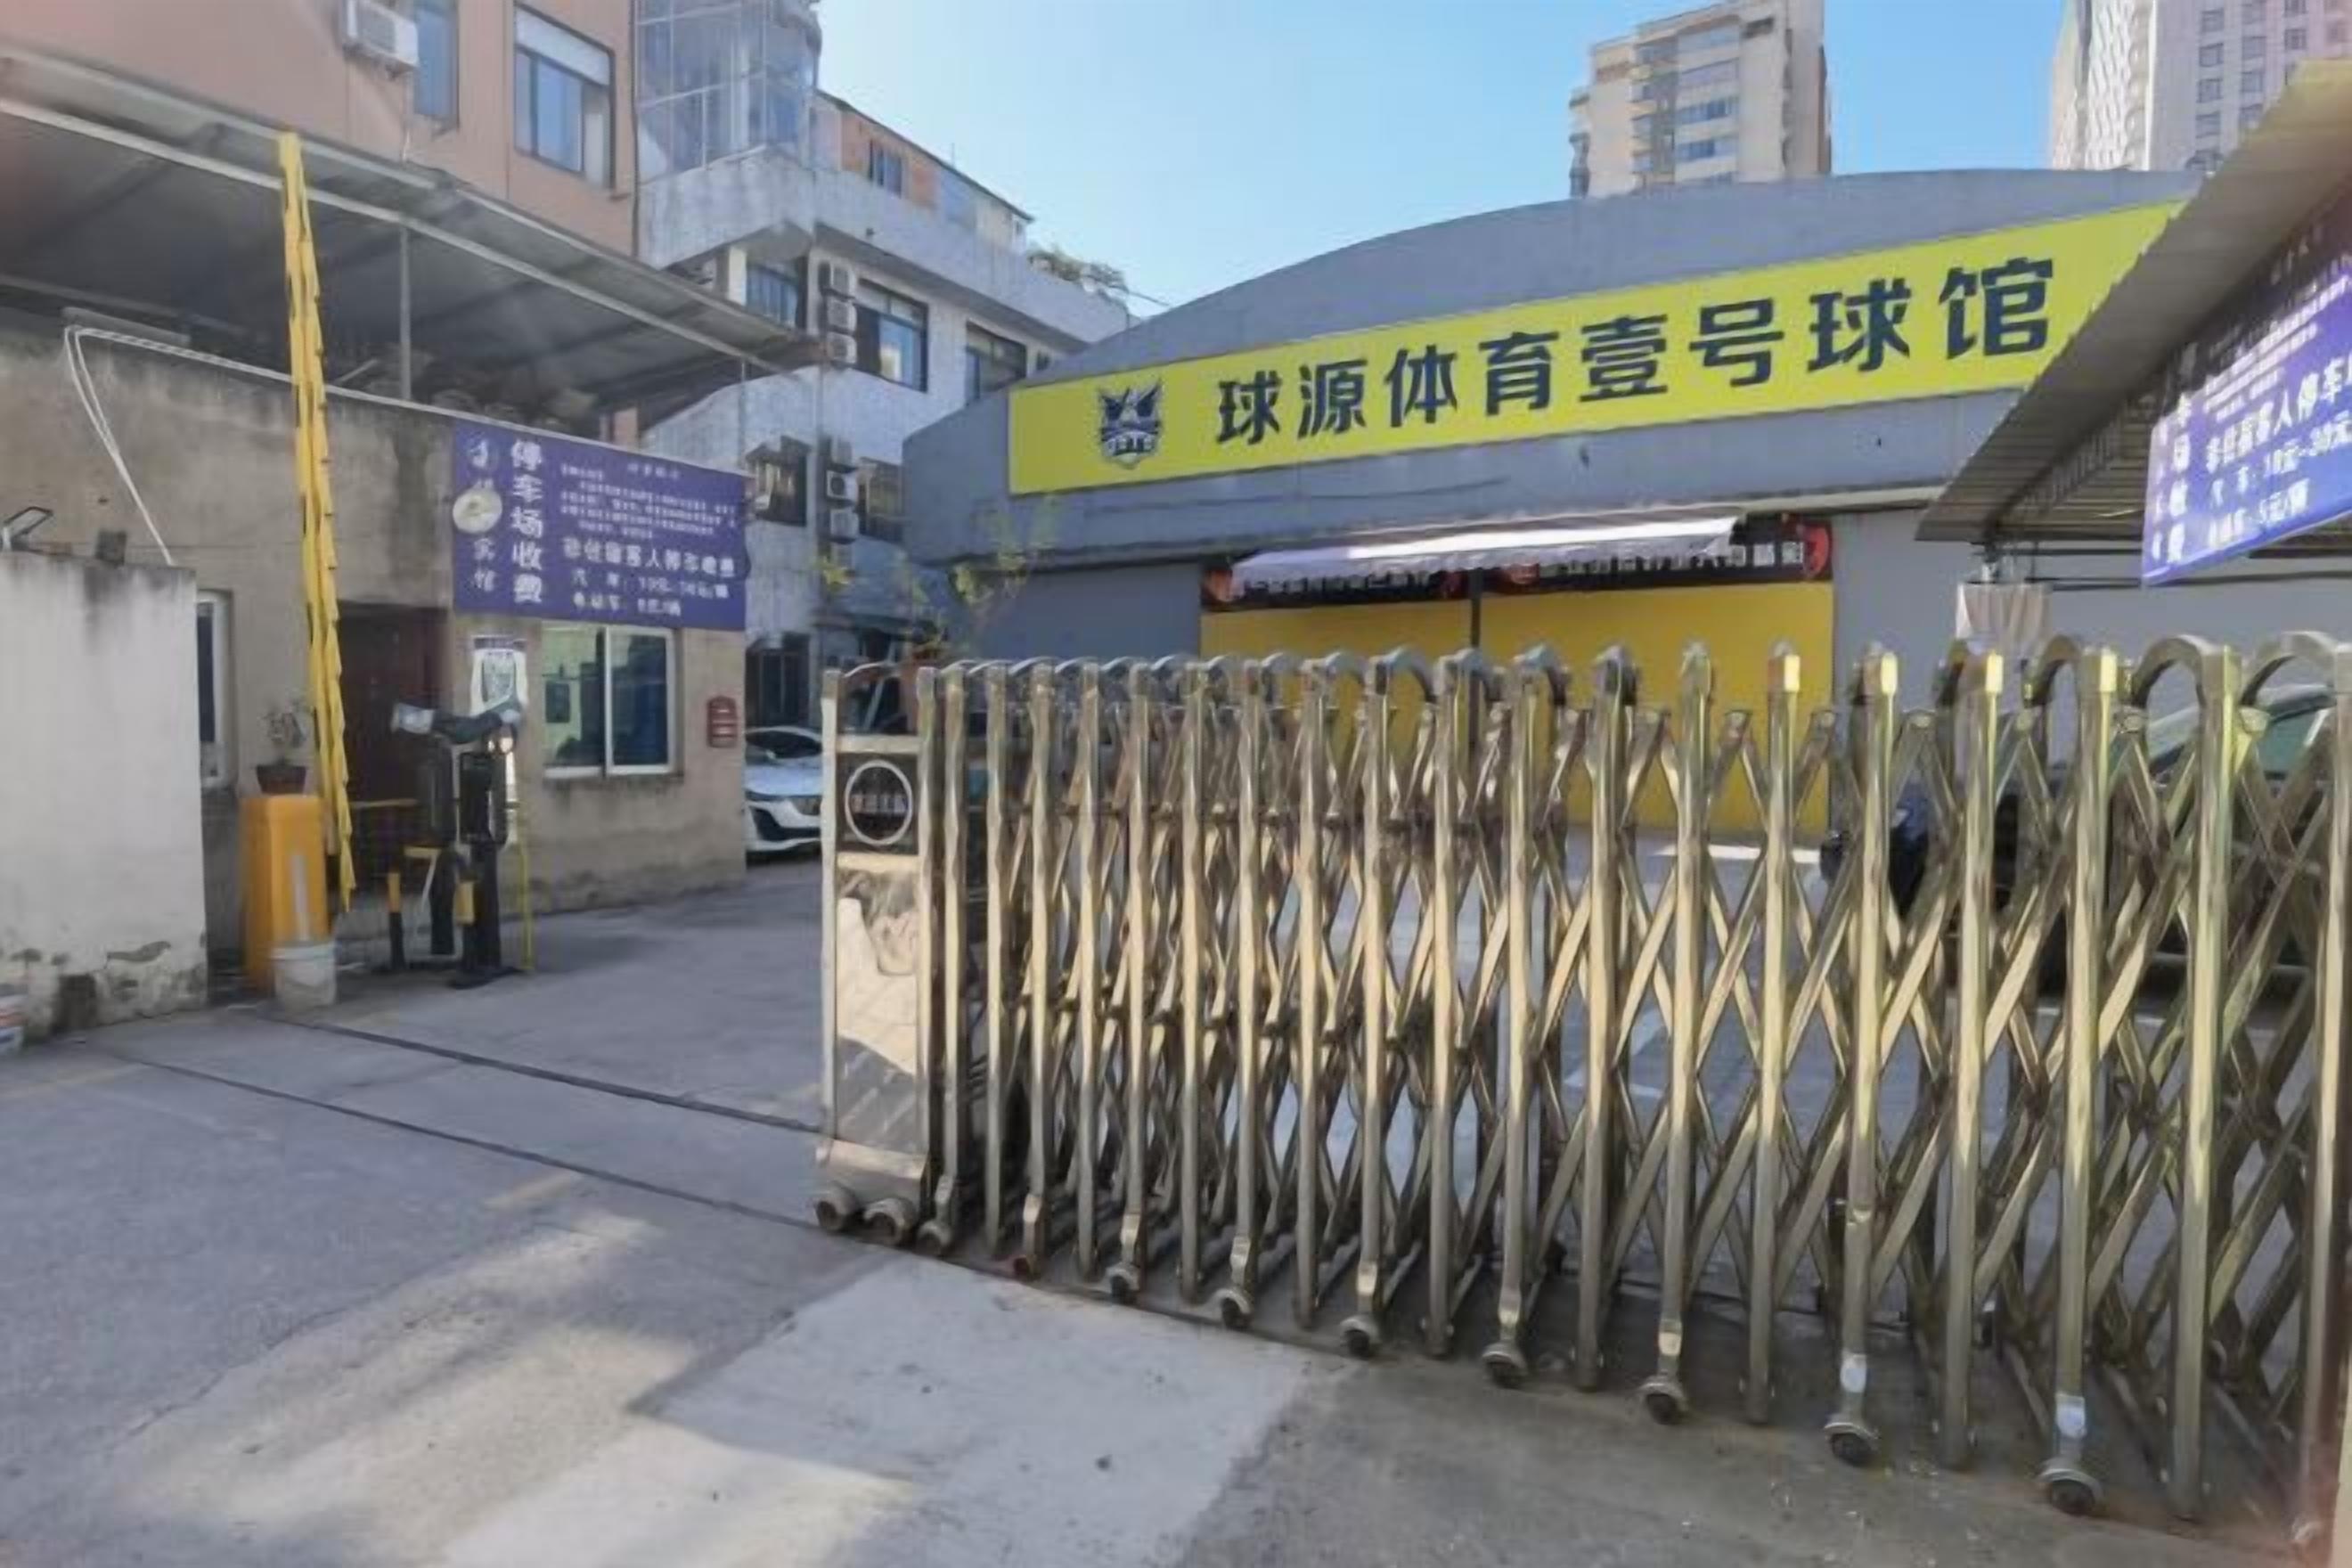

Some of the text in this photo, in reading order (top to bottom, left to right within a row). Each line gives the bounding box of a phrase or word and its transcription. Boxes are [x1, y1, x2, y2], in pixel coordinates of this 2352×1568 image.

[1216, 257, 2055, 445] 球源体育壹号球馆
